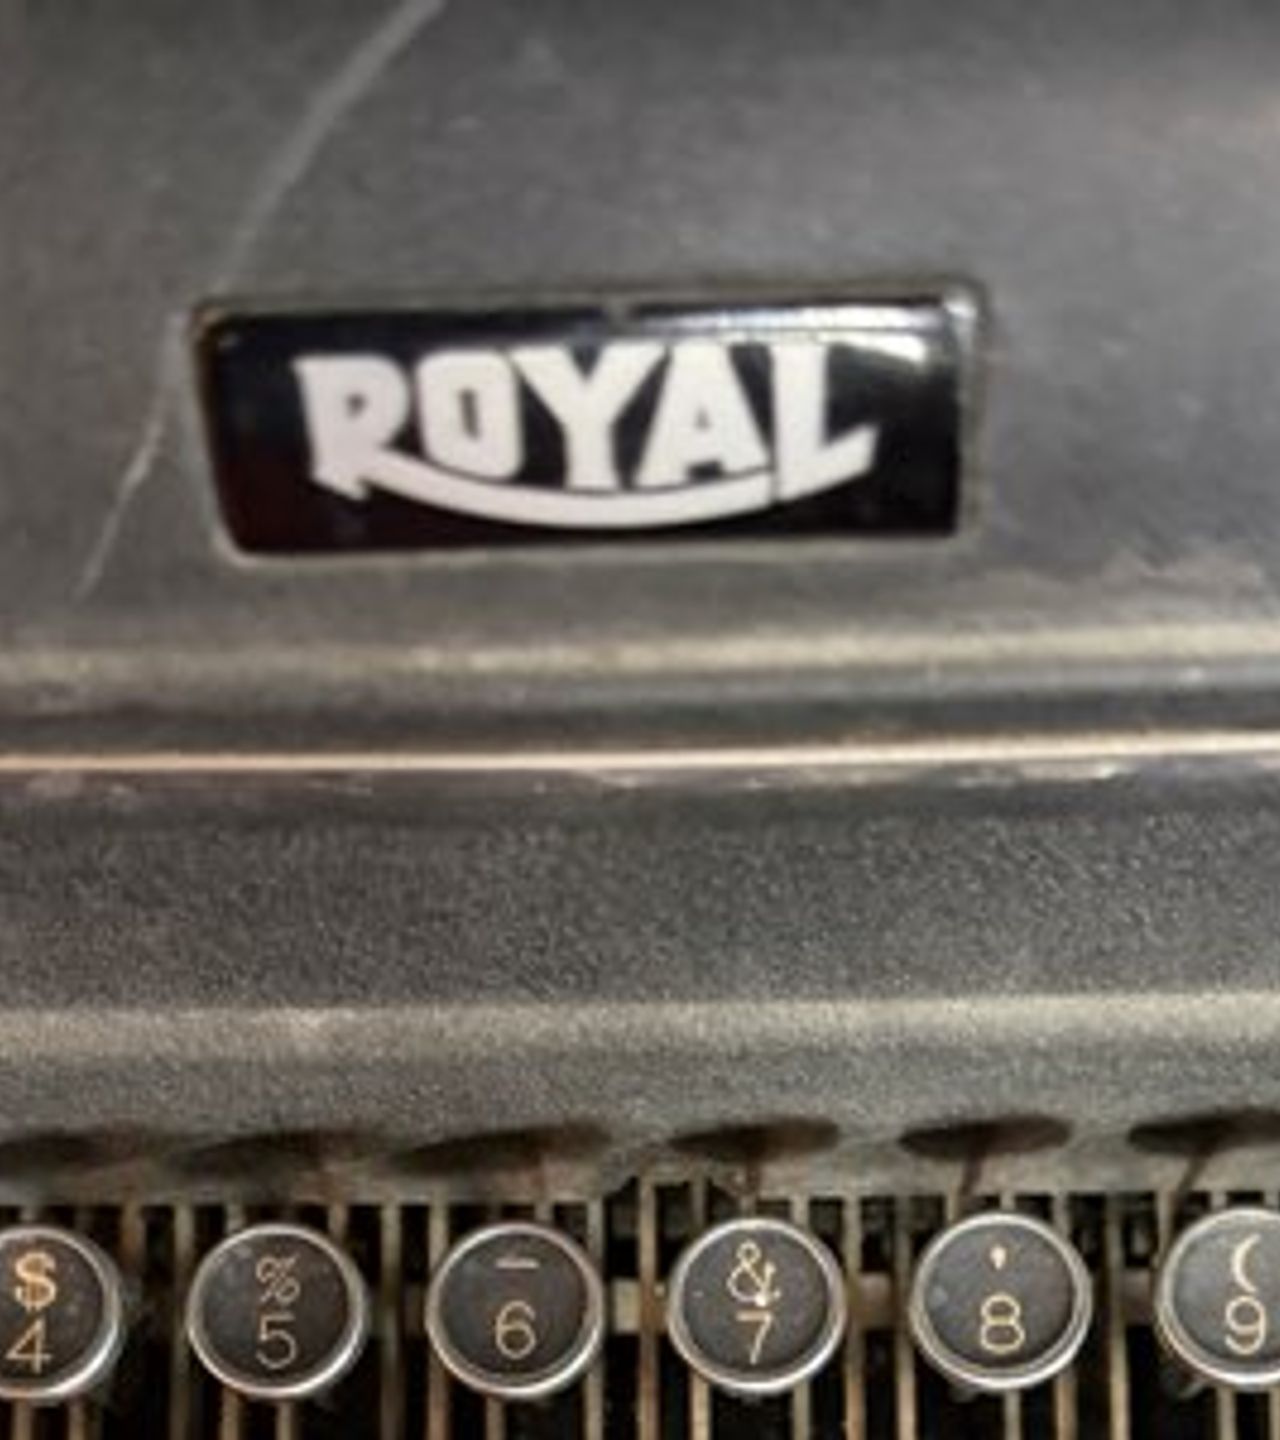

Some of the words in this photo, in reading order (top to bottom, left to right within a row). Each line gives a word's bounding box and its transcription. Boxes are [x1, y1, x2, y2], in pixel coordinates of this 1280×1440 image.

[294, 333, 879, 528] ROYAL
[14, 1251, 57, 1312] $
[255, 1254, 300, 1303] %
[727, 1242, 780, 1305] &
[1231, 1233, 1261, 1292] (
[7, 1320, 51, 1373] 4
[257, 1311, 297, 1368] 5
[495, 1300, 535, 1358] 6
[737, 1310, 773, 1364] 7
[980, 1295, 1024, 1351] 8
[1224, 1297, 1267, 1353] 9
